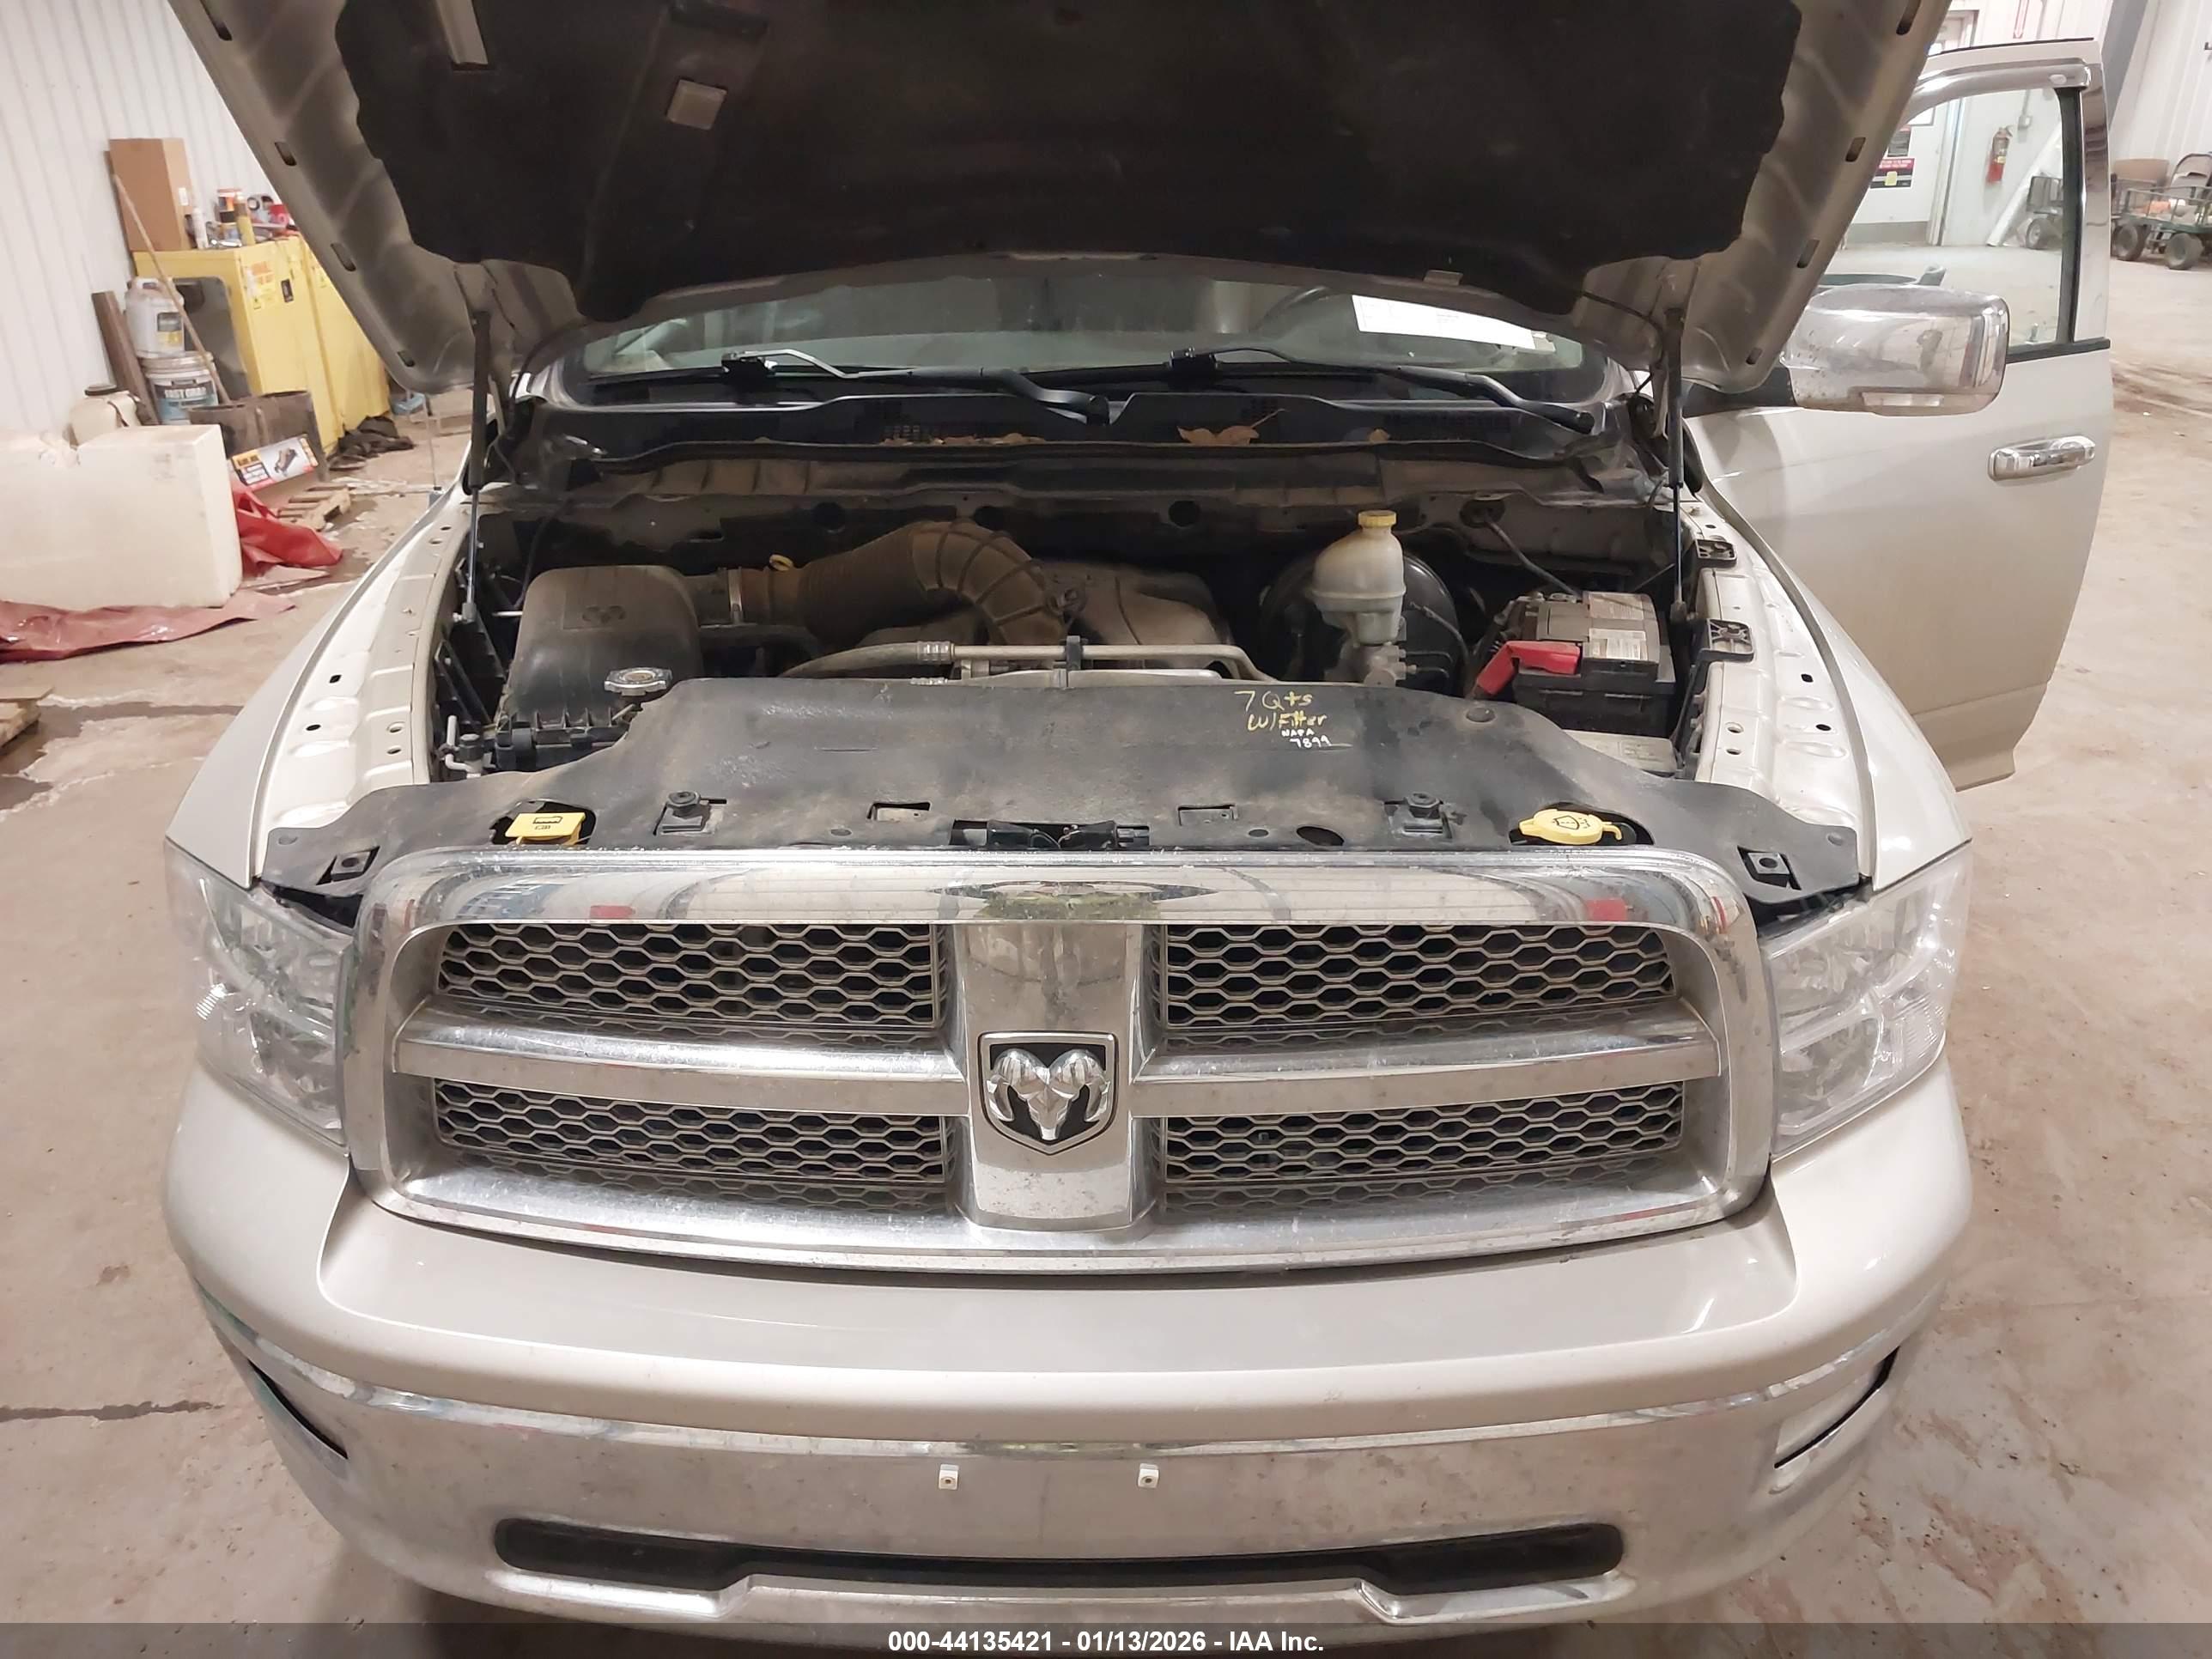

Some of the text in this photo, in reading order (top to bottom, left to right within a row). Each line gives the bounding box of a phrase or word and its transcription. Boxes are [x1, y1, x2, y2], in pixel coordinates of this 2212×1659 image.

[1234, 690, 1313, 712] 7 Qts
[1281, 728, 1315, 738] NAPA
